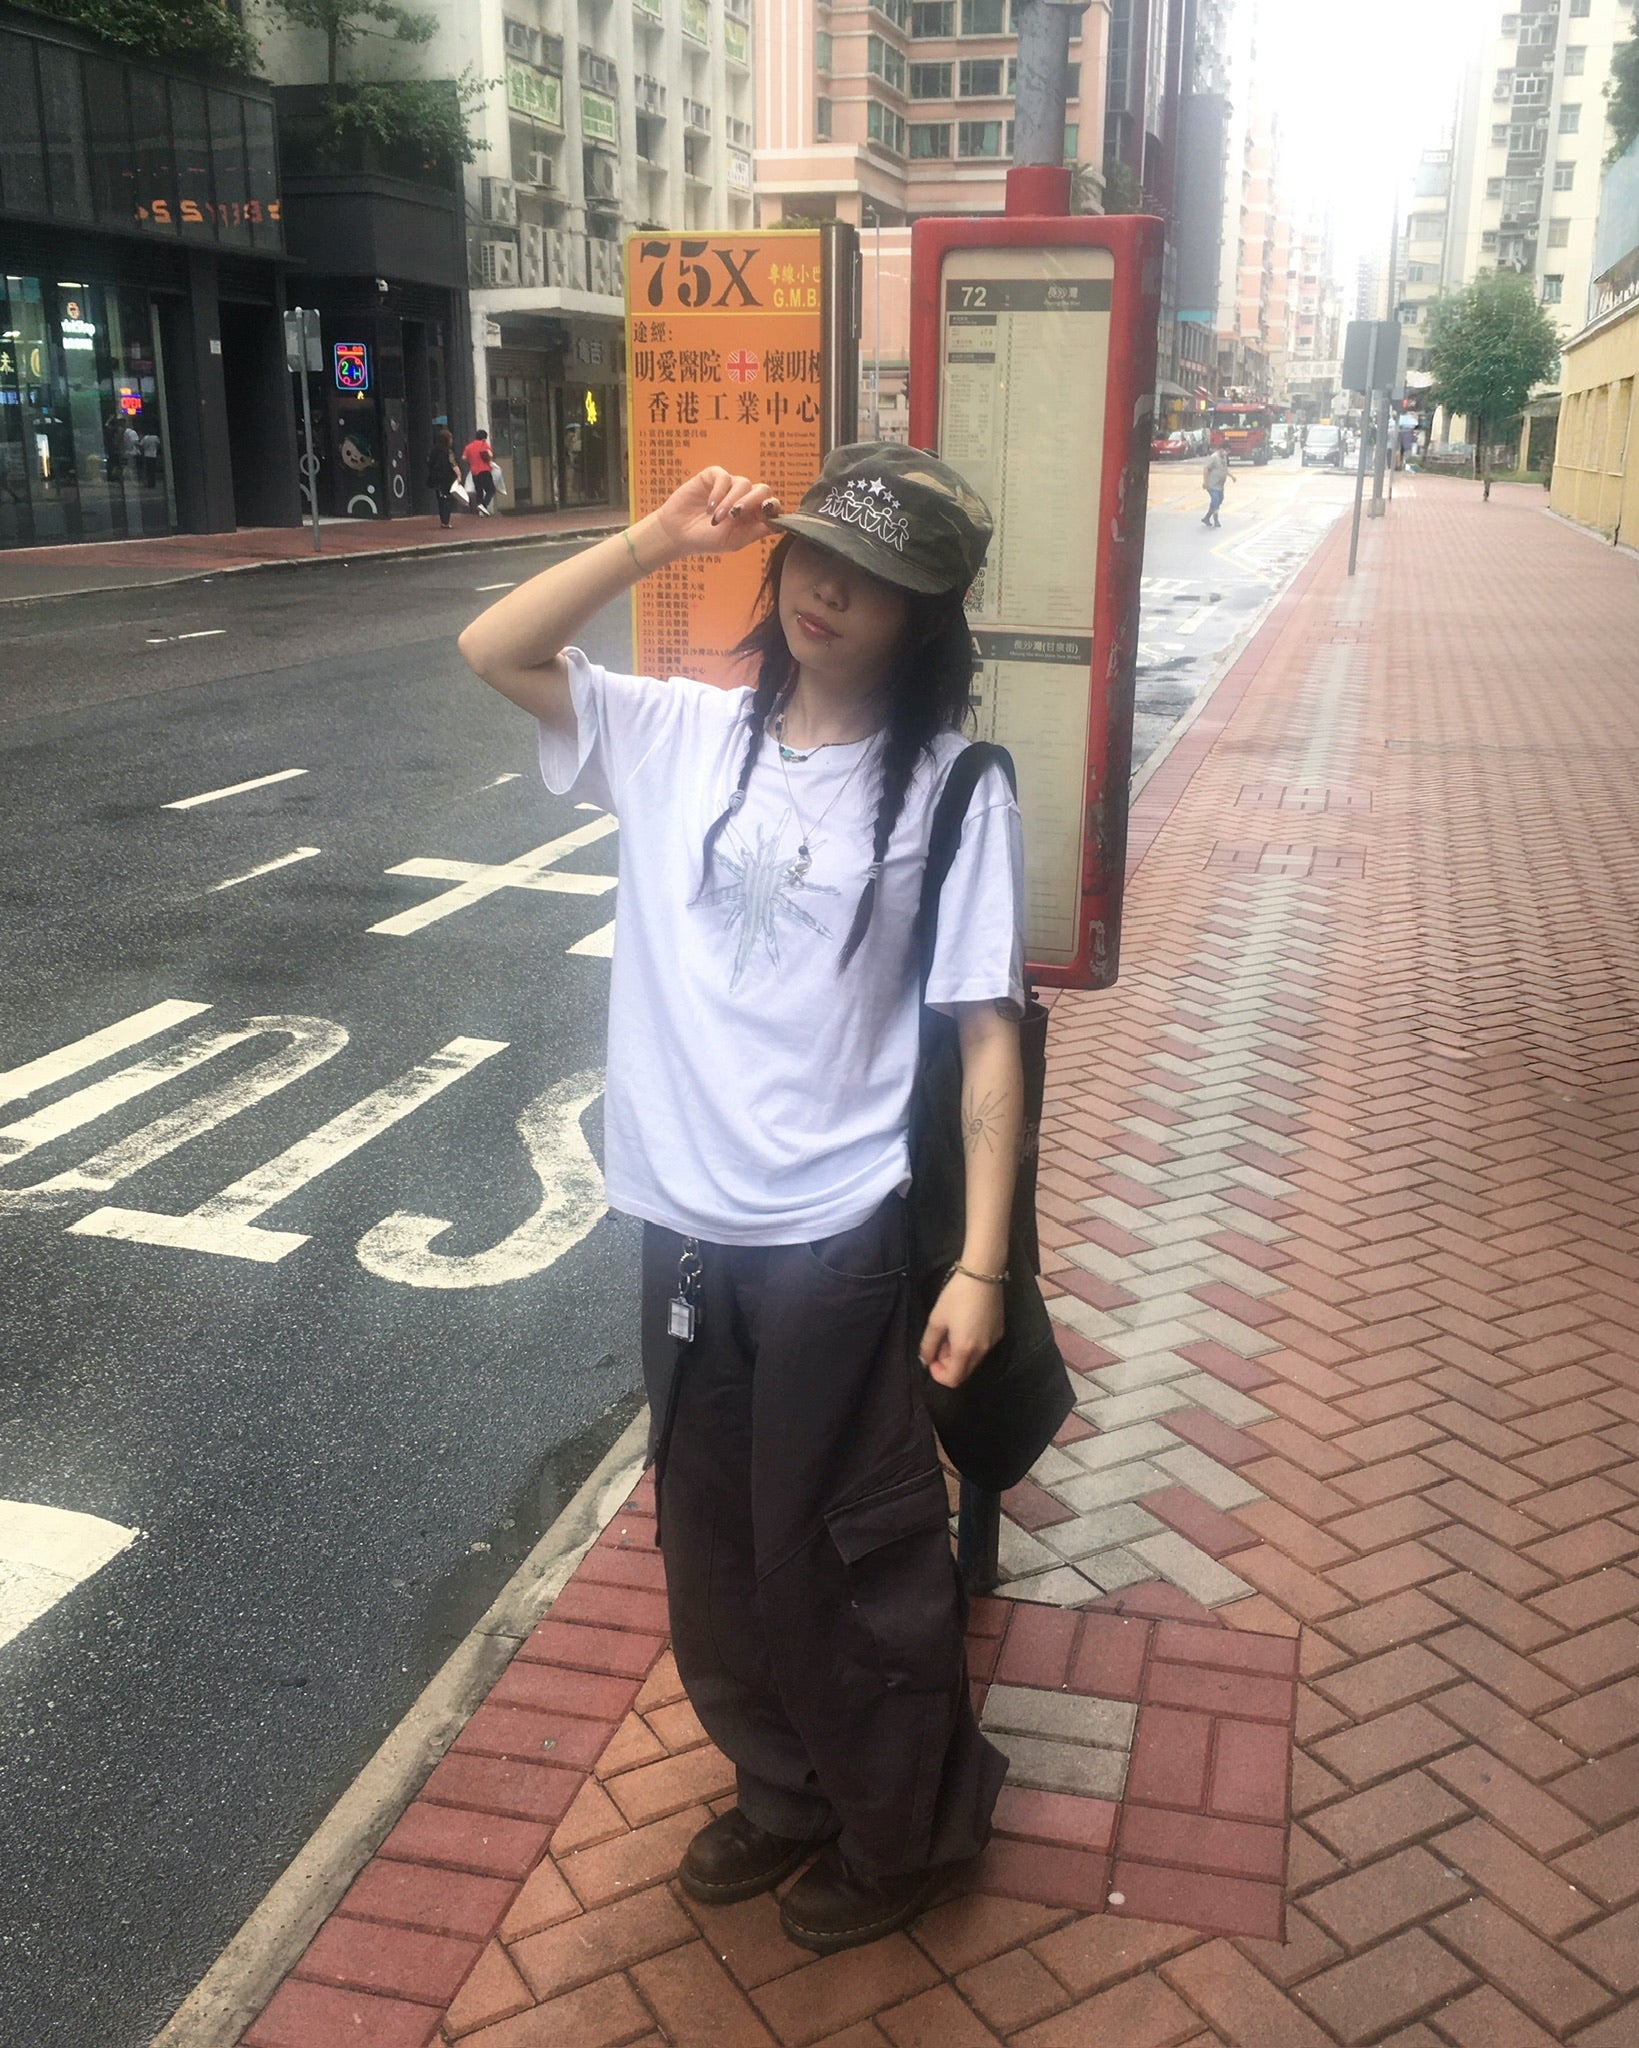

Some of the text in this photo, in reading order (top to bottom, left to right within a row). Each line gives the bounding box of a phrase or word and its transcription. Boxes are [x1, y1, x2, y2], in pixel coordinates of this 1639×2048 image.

[640, 240, 763, 308] 75X
[961, 286, 987, 308] 72
[634, 349, 721, 384] 明愛醫院
[647, 391, 820, 425] 香港工業中心
